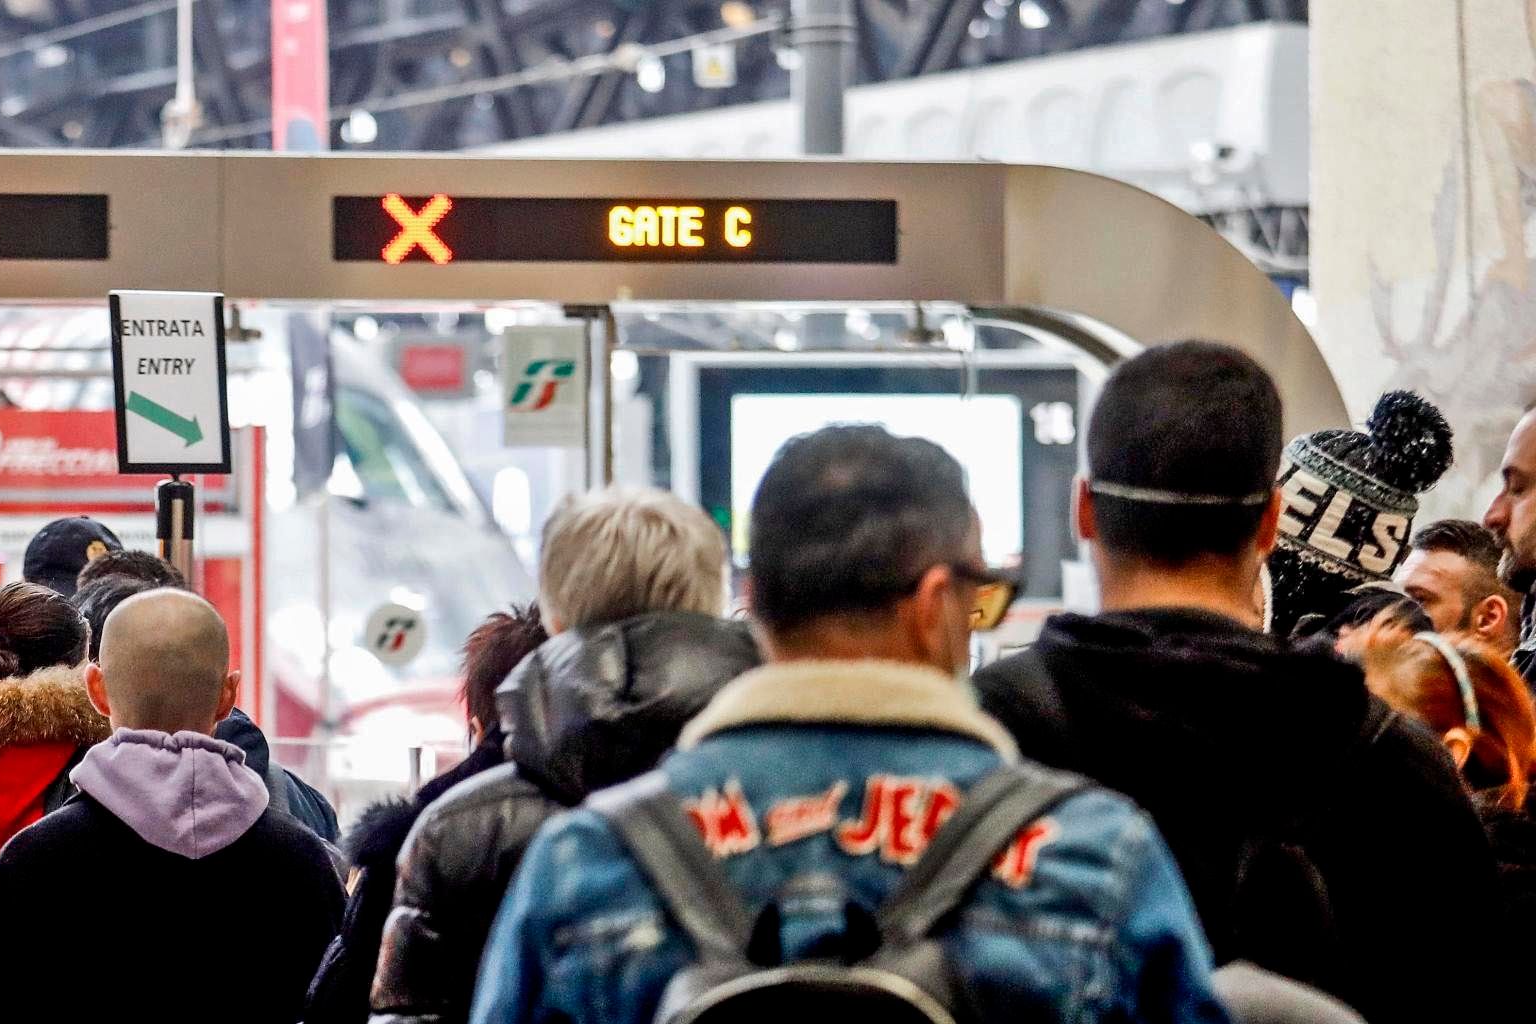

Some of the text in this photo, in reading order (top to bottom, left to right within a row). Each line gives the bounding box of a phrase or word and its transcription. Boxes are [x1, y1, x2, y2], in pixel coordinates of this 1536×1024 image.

[608, 205, 752, 247] GATE C
[121, 319, 205, 337] ENTRATA
[137, 358, 196, 376] ENTRY
